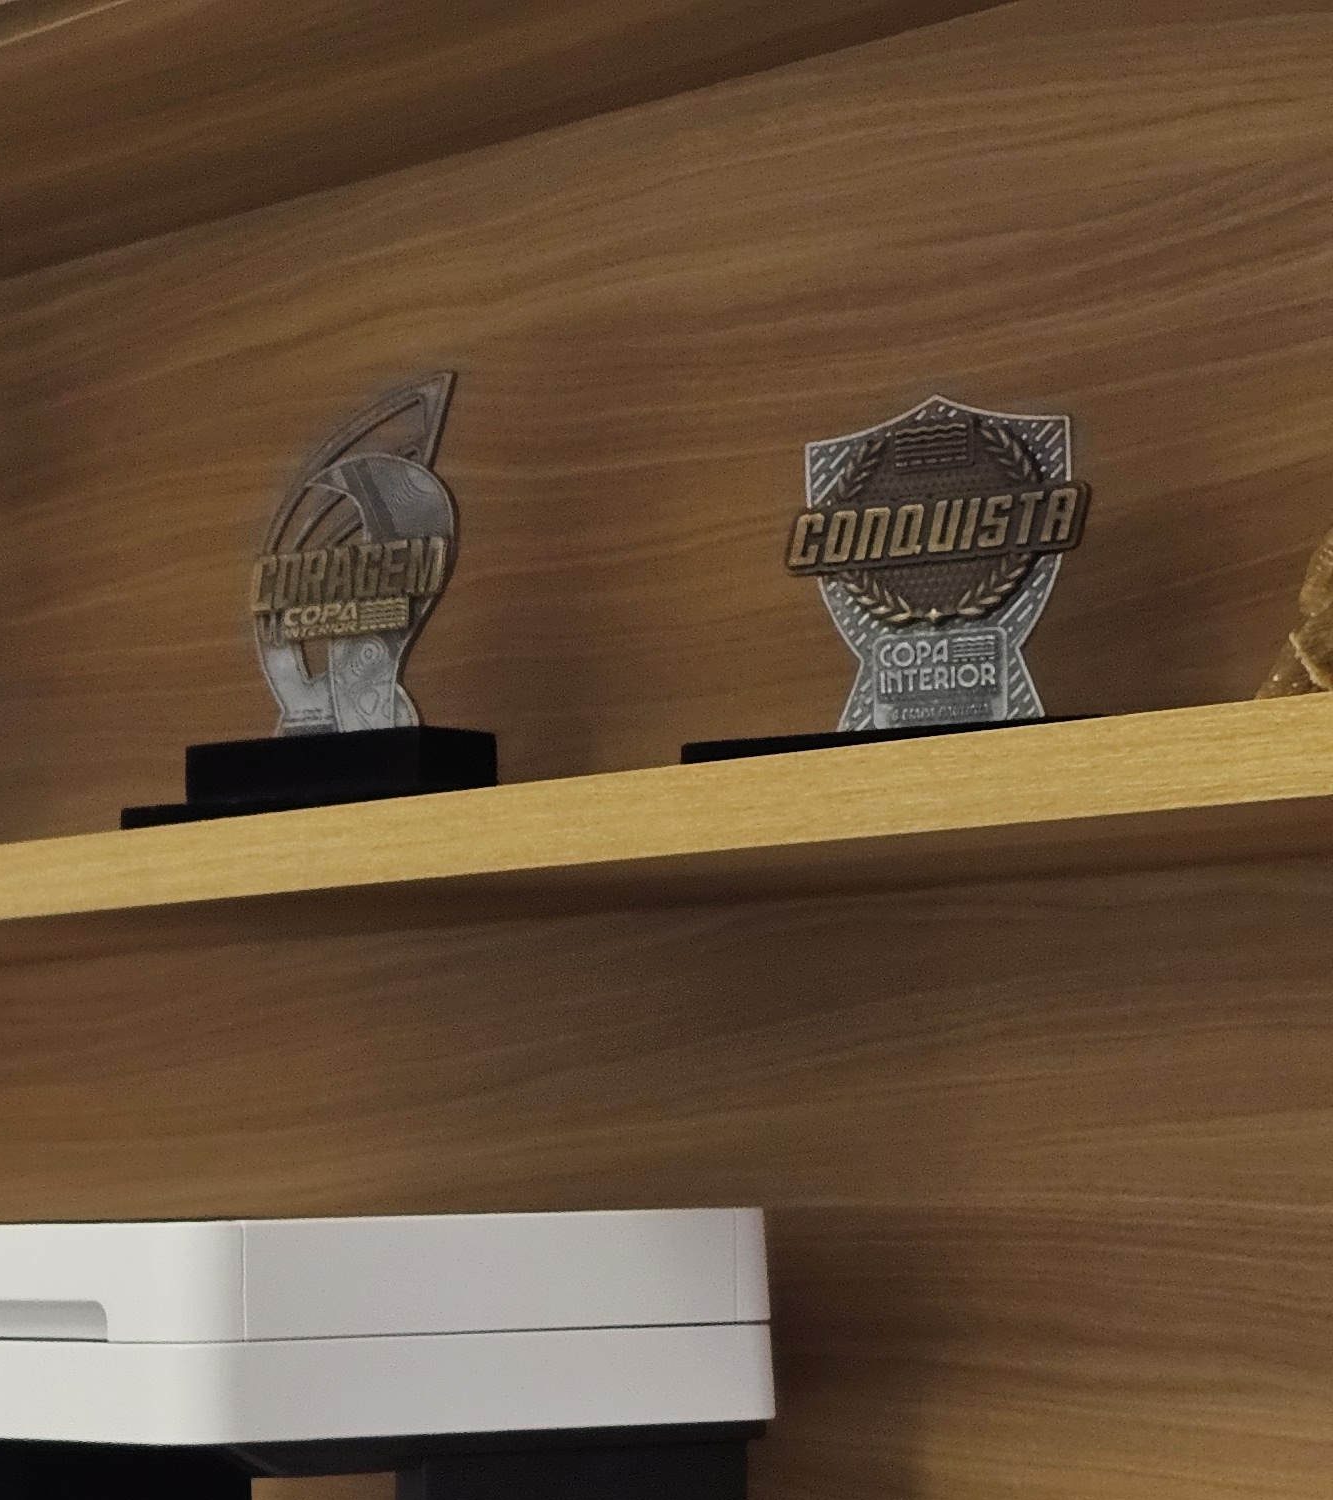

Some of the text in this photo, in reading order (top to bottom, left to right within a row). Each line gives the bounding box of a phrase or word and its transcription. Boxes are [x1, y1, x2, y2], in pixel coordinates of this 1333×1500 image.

[788, 486, 1078, 567] CONQUISTA
[250, 537, 446, 611] CORAGEM
[284, 602, 358, 627] COPA
[880, 638, 948, 667] COPA
[880, 661, 995, 694] INTERIOR
